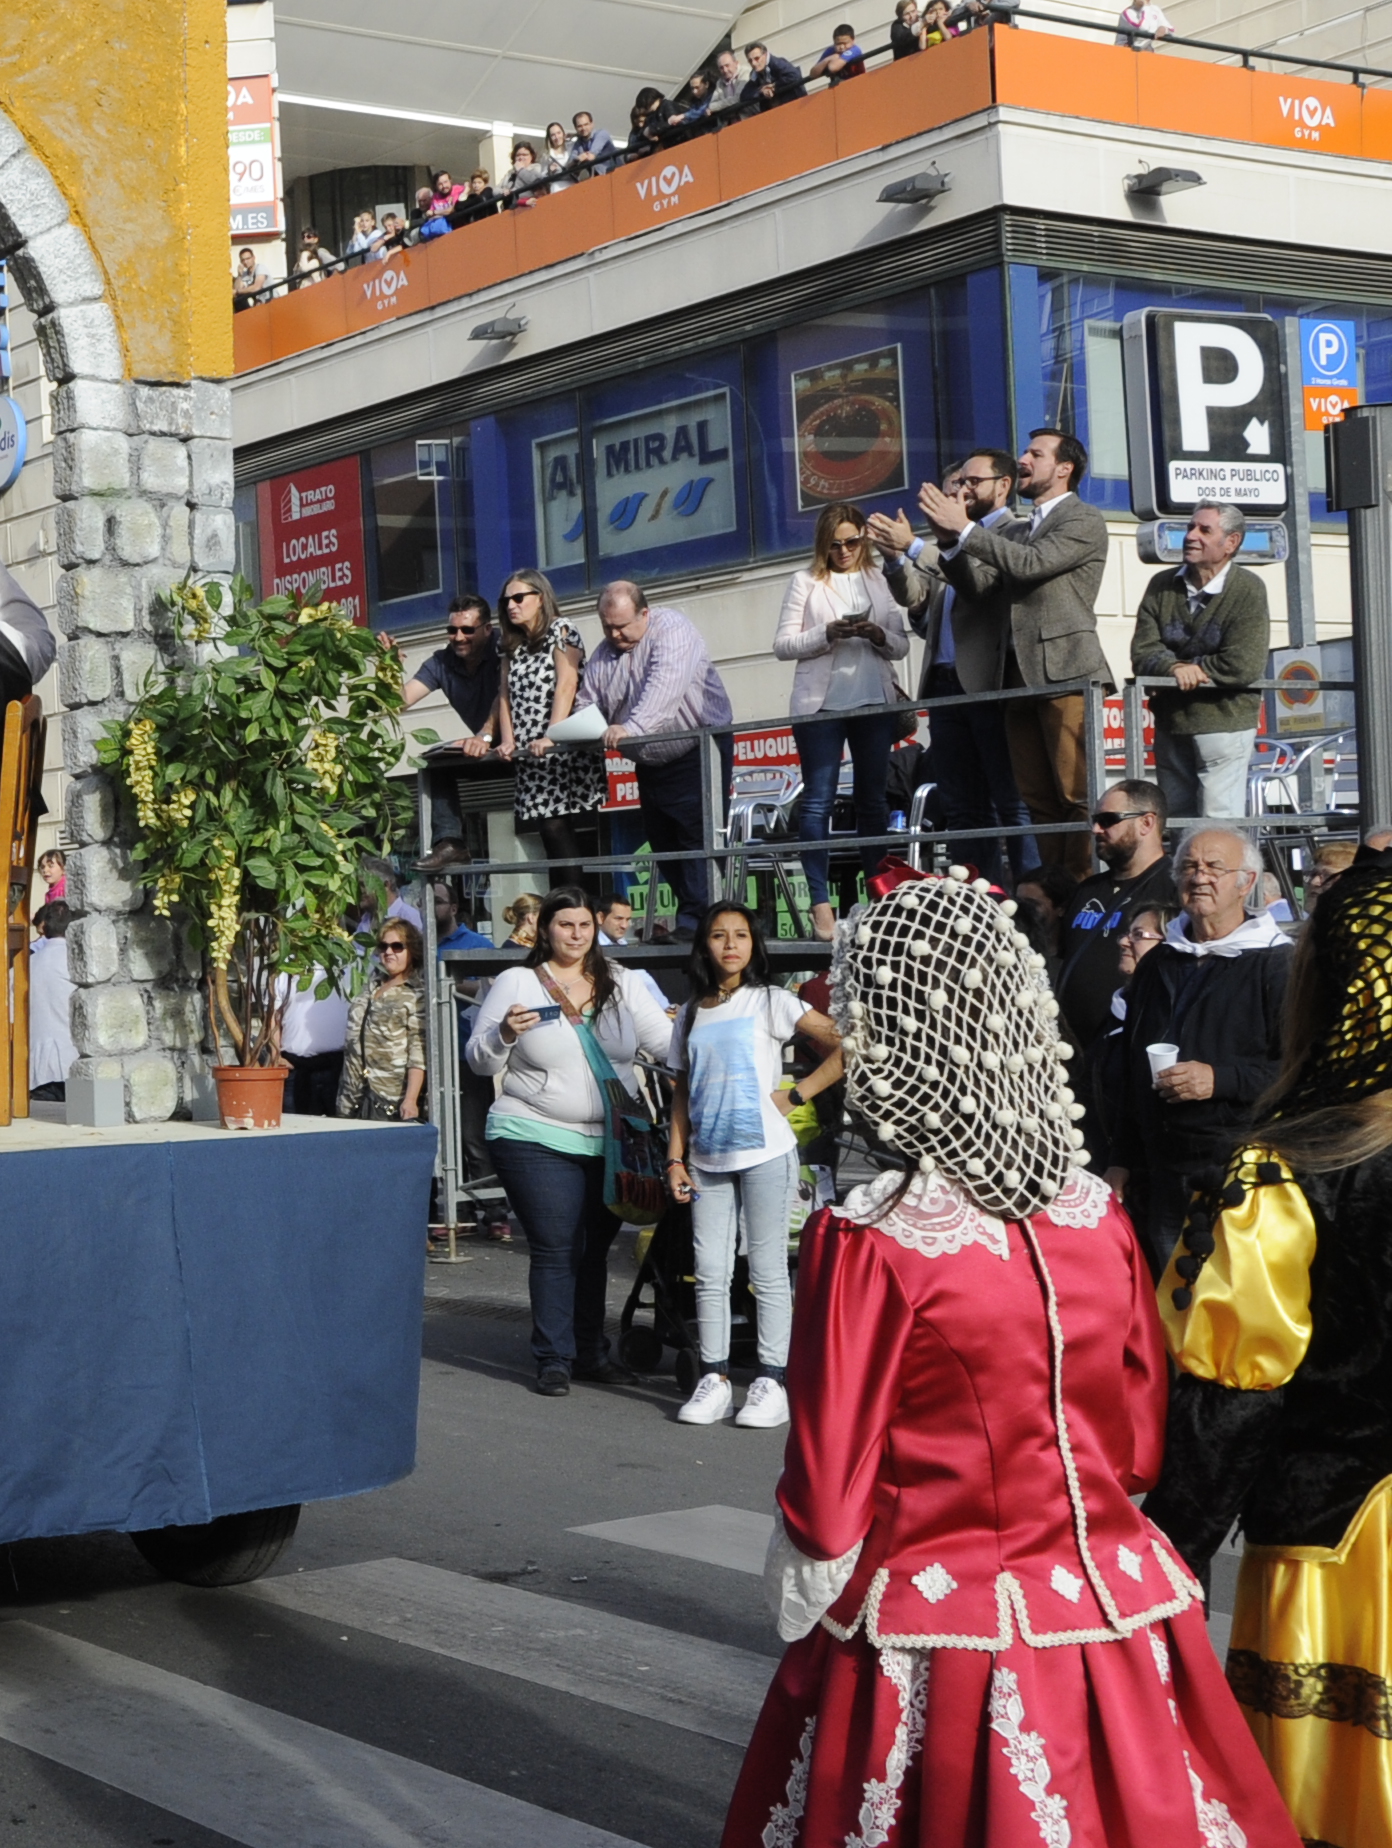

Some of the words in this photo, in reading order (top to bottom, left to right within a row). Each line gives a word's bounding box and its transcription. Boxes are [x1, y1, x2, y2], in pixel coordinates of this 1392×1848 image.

[1278, 95, 1336, 127] VIVA
[1294, 127, 1320, 142] GYM
[635, 164, 695, 201] VIVA
[653, 194, 679, 212] GYM
[363, 269, 409, 300] VIVA
[376, 295, 397, 310] GYM
[1318, 332, 1339, 366] P
[1174, 321, 1265, 452] P
[1309, 394, 1351, 415] VIVA
[546, 419, 729, 503] AMIRAL
[1174, 466, 1227, 482] PARKING
[1230, 468, 1280, 483] PUBLICO
[300, 484, 336, 505] TRATO
[1197, 486, 1217, 498] DOS
[1219, 486, 1232, 498] DE
[1234, 487, 1260, 498] MAYO
[282, 528, 339, 564] LOCALES
[273, 560, 352, 597] DISPONIBLES
